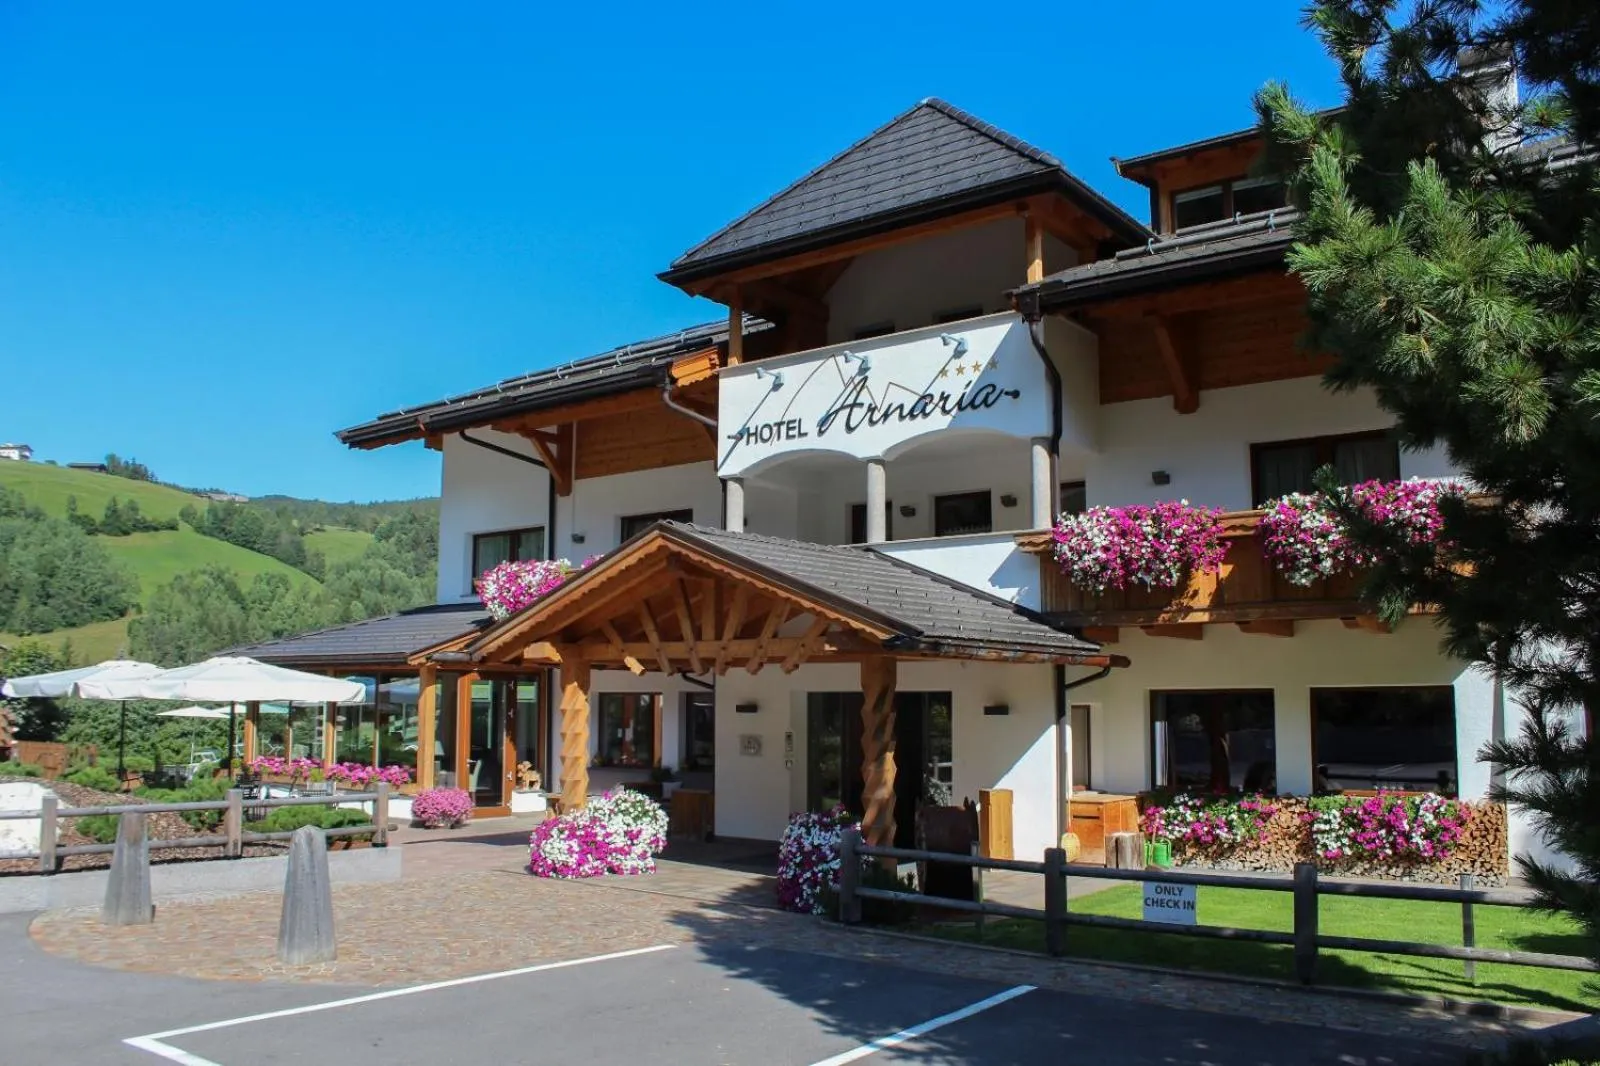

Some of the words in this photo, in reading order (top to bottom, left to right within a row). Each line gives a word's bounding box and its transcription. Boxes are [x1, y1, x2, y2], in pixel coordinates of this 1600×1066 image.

[745, 417, 808, 446] HOTEL
[1155, 884, 1184, 896] ONLY
[1144, 896, 1180, 909] CHECK
[1183, 900, 1195, 910] IN
